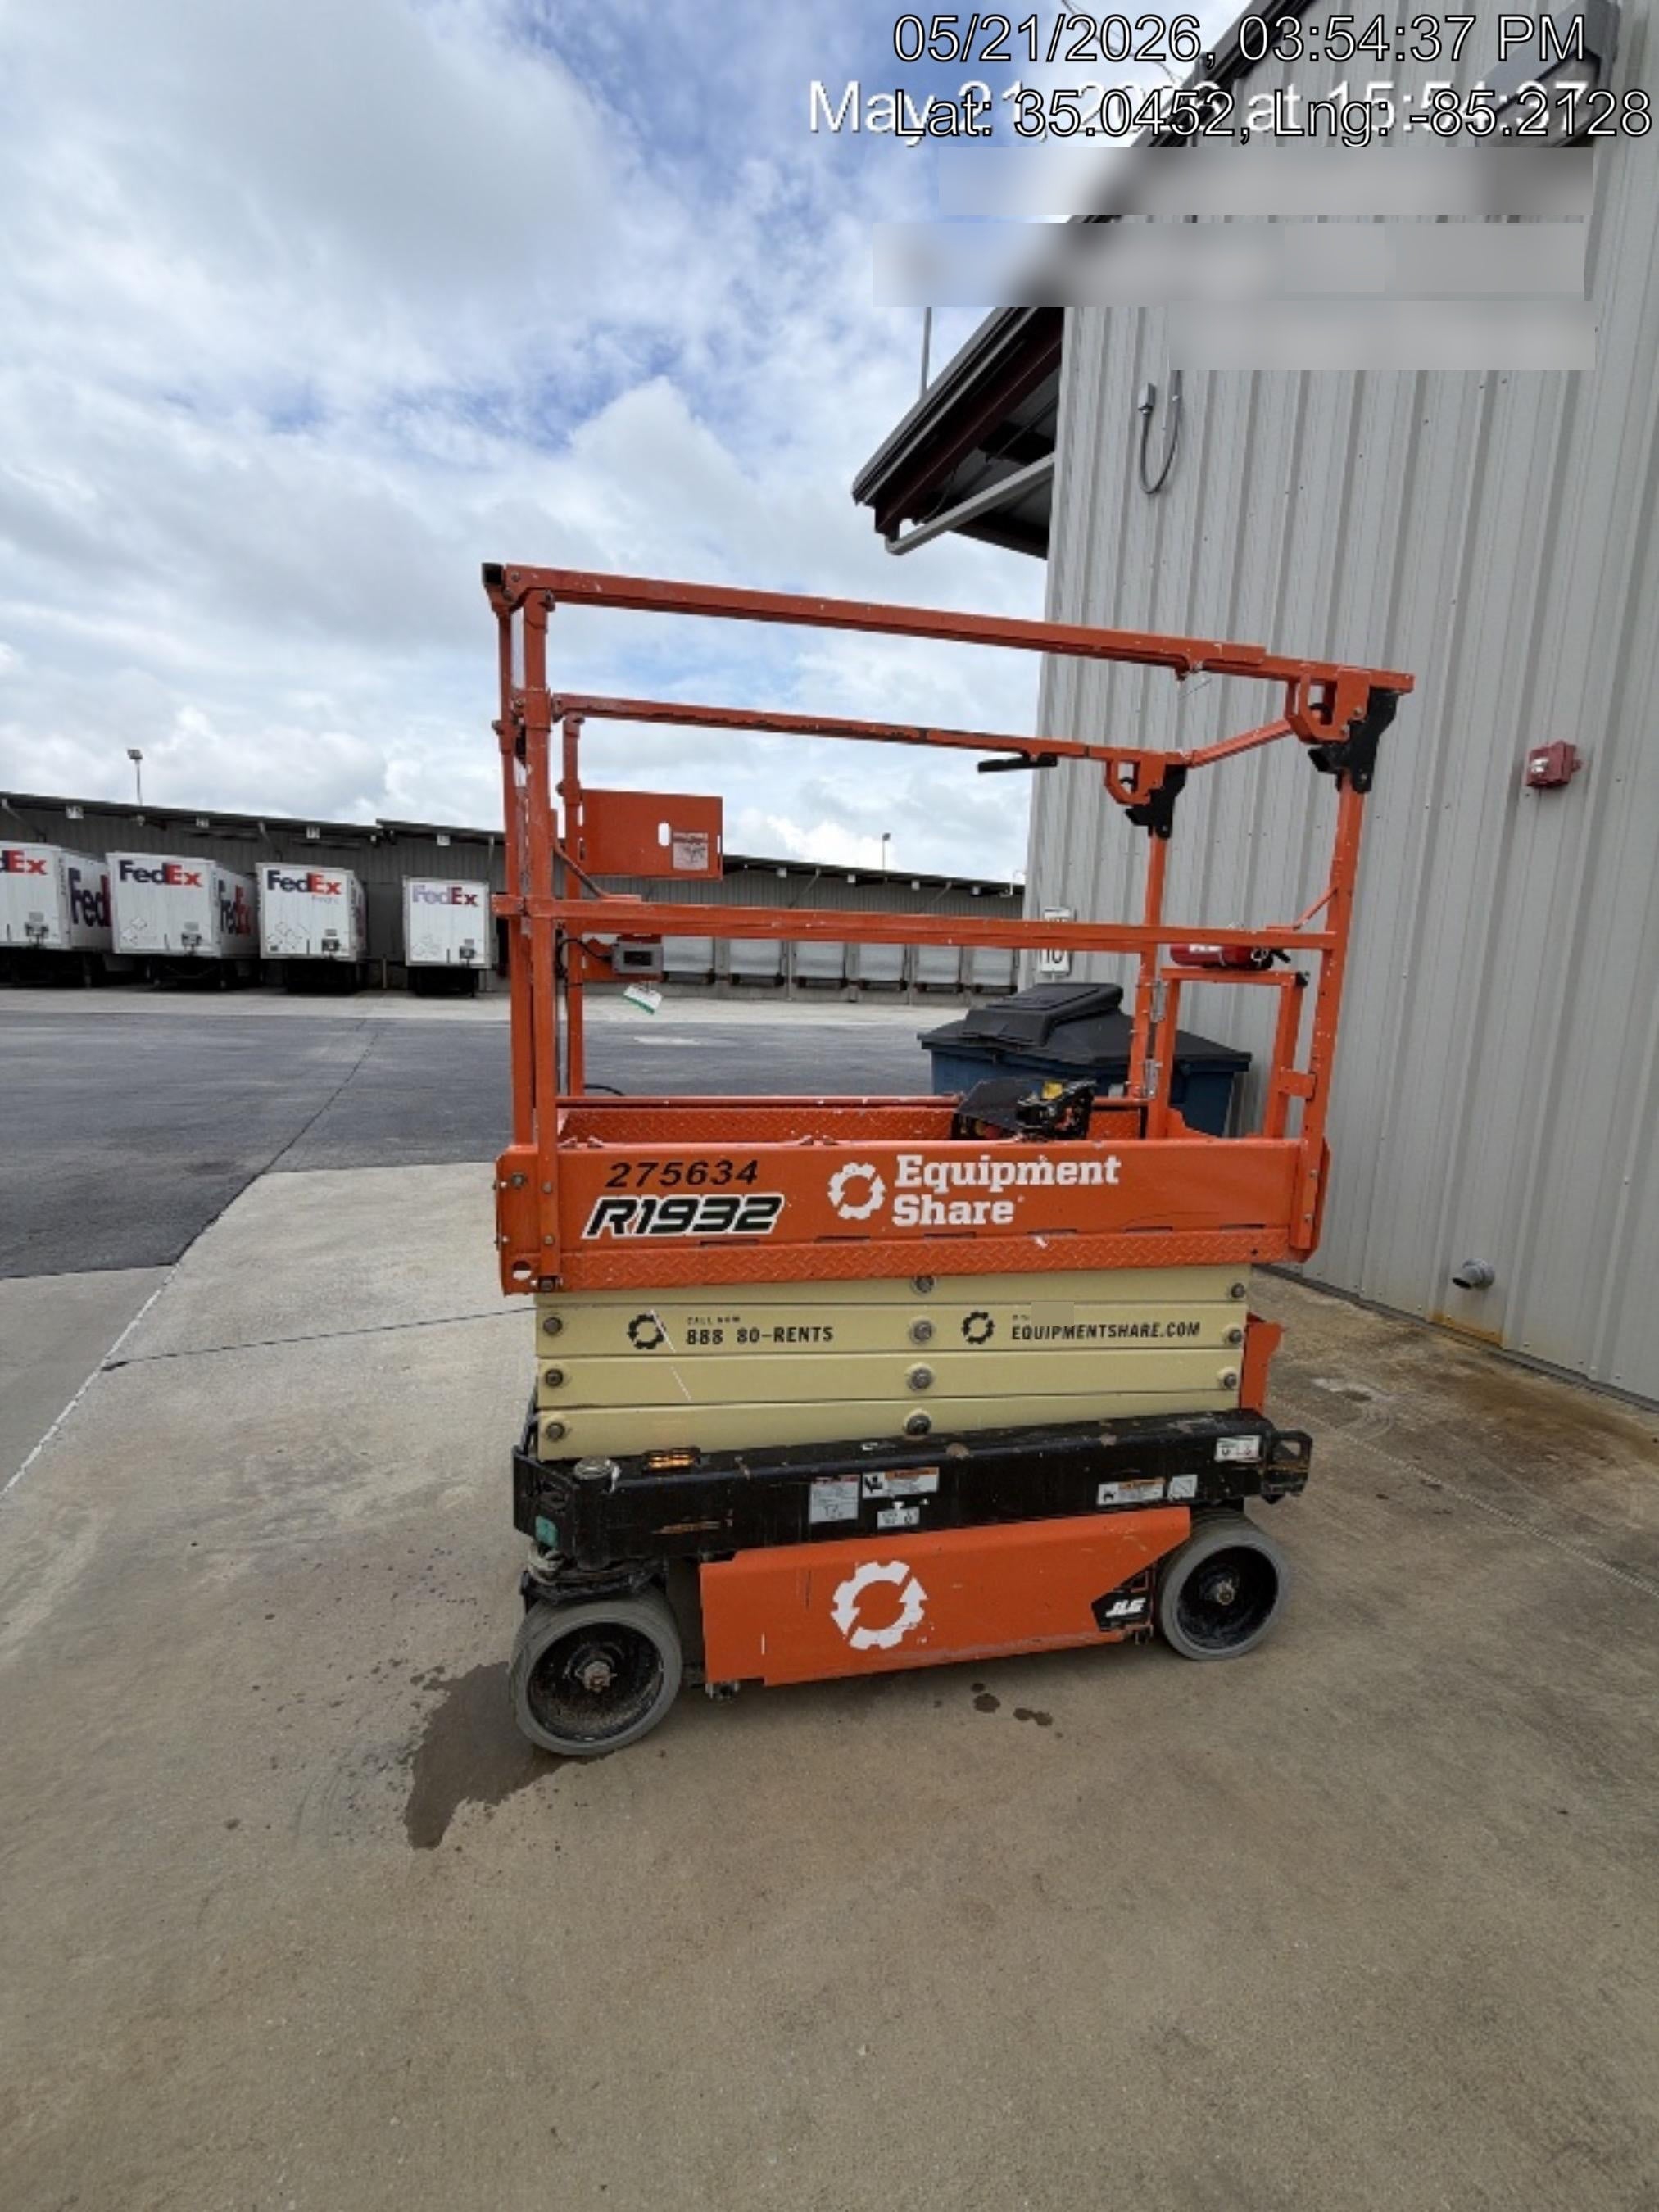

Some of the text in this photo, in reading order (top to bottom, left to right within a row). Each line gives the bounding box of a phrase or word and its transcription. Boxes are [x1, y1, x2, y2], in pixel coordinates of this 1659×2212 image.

[120, 859, 202, 887] FedEx
[267, 869, 342, 895] FedEx
[412, 884, 478, 907] FedEx
[605, 1159, 759, 1187] 275634
[894, 1154, 1122, 1194] Equipment
[580, 1190, 785, 1240] R1932
[892, 1193, 1014, 1227] Share
[687, 1326, 834, 1345] 888 80-RENTS
[1011, 1321, 1201, 1340] EQUIPMENTSHARE.COM
